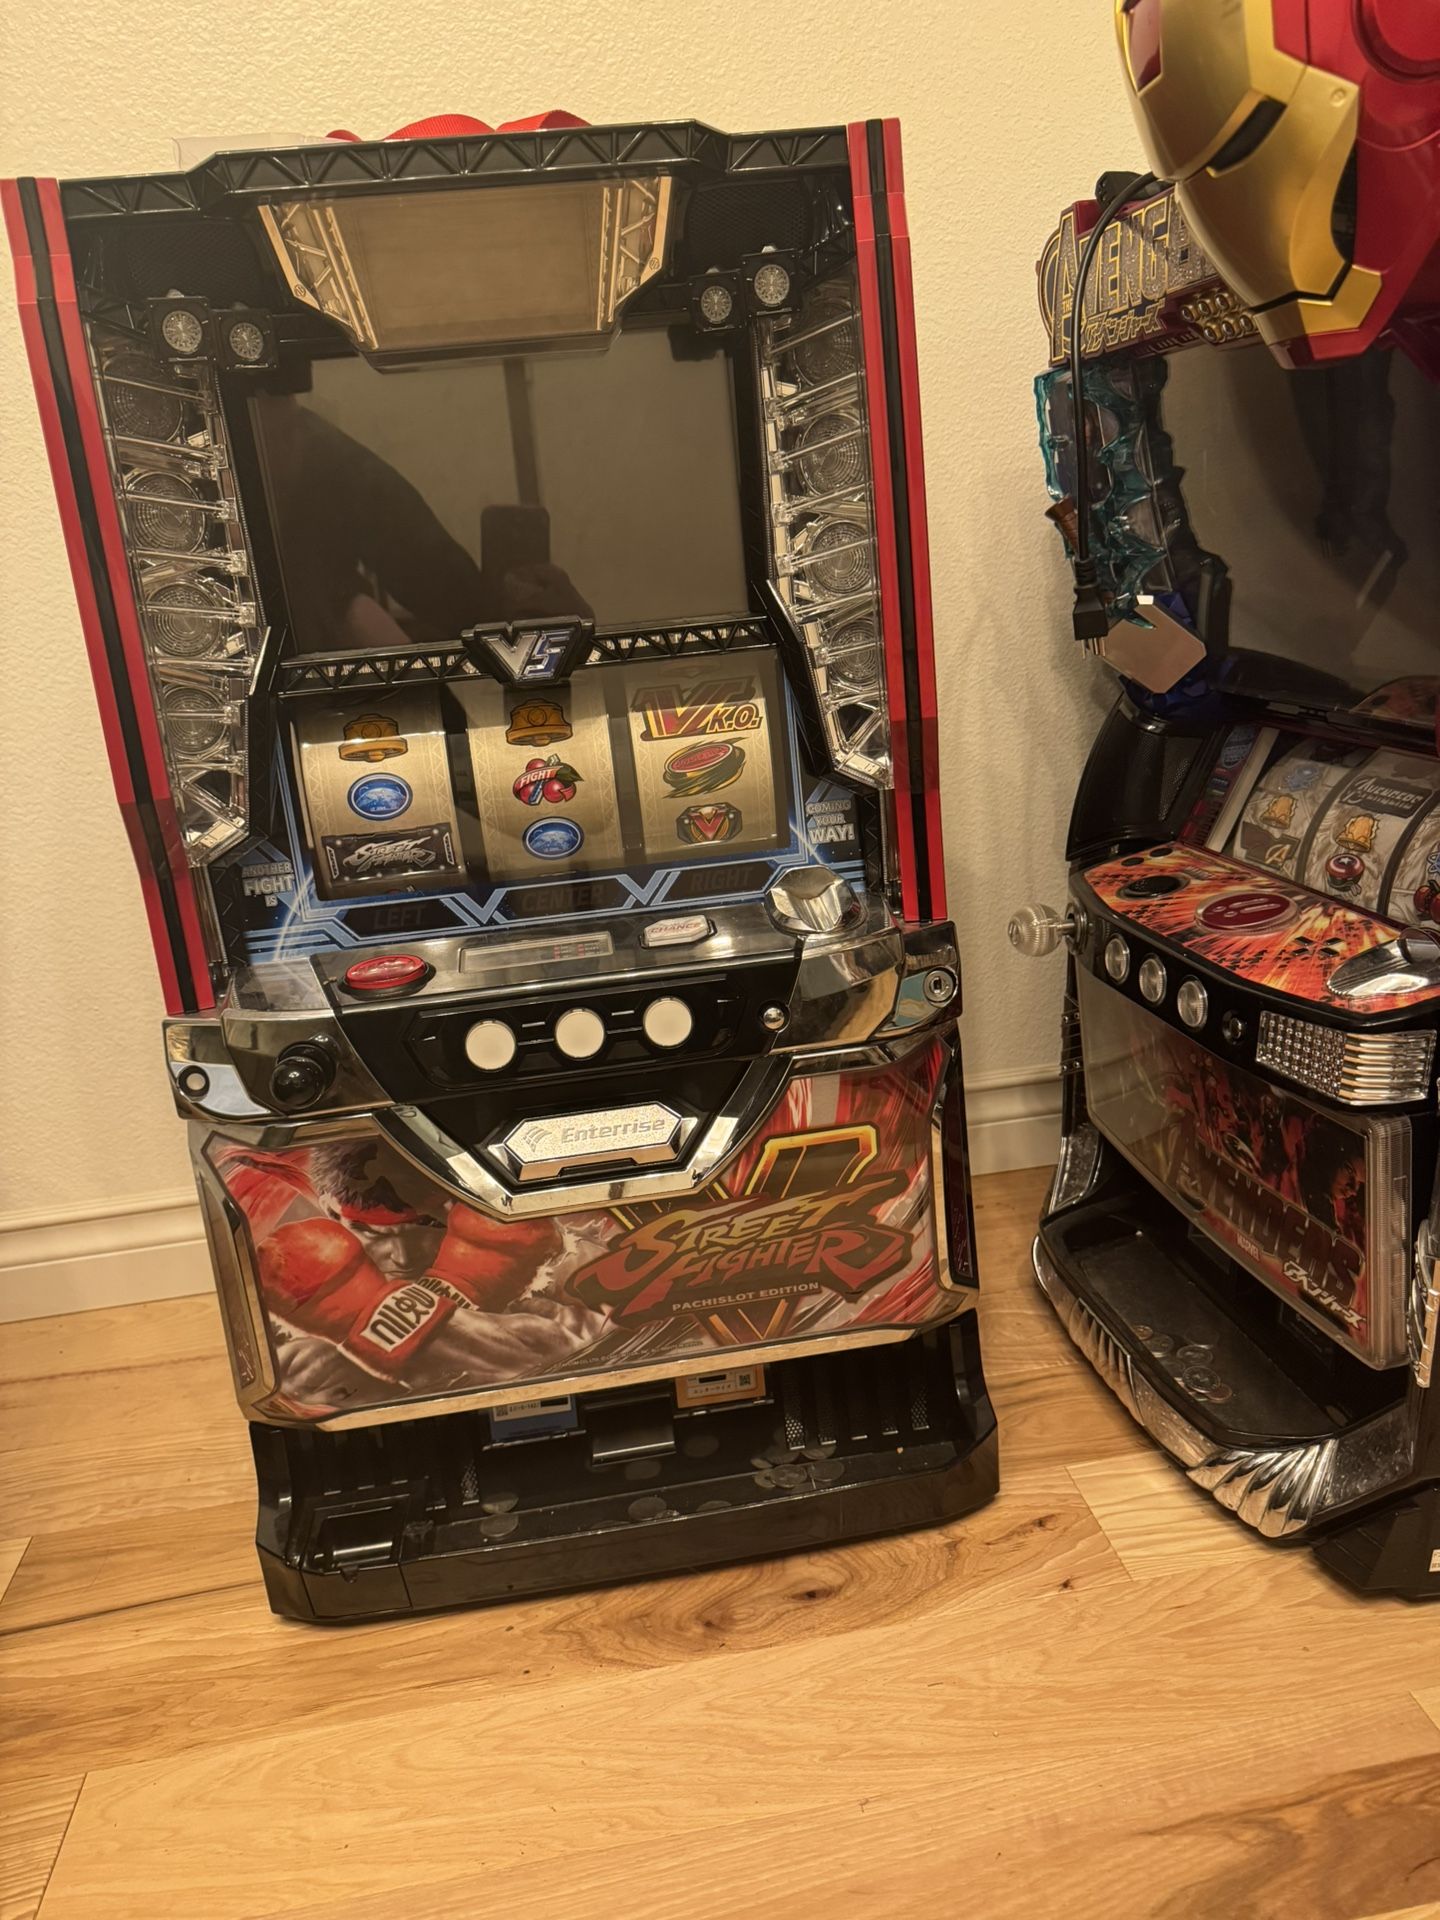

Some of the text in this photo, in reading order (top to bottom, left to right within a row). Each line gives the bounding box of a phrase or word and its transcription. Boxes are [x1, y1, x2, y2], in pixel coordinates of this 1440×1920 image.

[1049, 190, 1215, 361] AVENGE
[1083, 302, 1166, 353] アベンジャーズ
[705, 703, 764, 734] K.O.
[520, 769, 552, 788] FIGHT
[805, 800, 852, 814] COMING
[814, 813, 846, 827] YOUR
[808, 823, 856, 845] WAY!
[342, 836, 432, 866] STREET
[241, 862, 293, 878] ANOTHER
[243, 874, 295, 897] FIGHT
[369, 866, 755, 930] LEFT CENTER RIGHT
[650, 921, 701, 935] CHANCE
[560, 1118, 666, 1144] Enterrise
[573, 1177, 897, 1292] STREET
[619, 1221, 906, 1318] FIGHTER
[671, 1281, 820, 1312] PACHISLOT EDITION
[1283, 1260, 1368, 1329] アベンジャーズ
